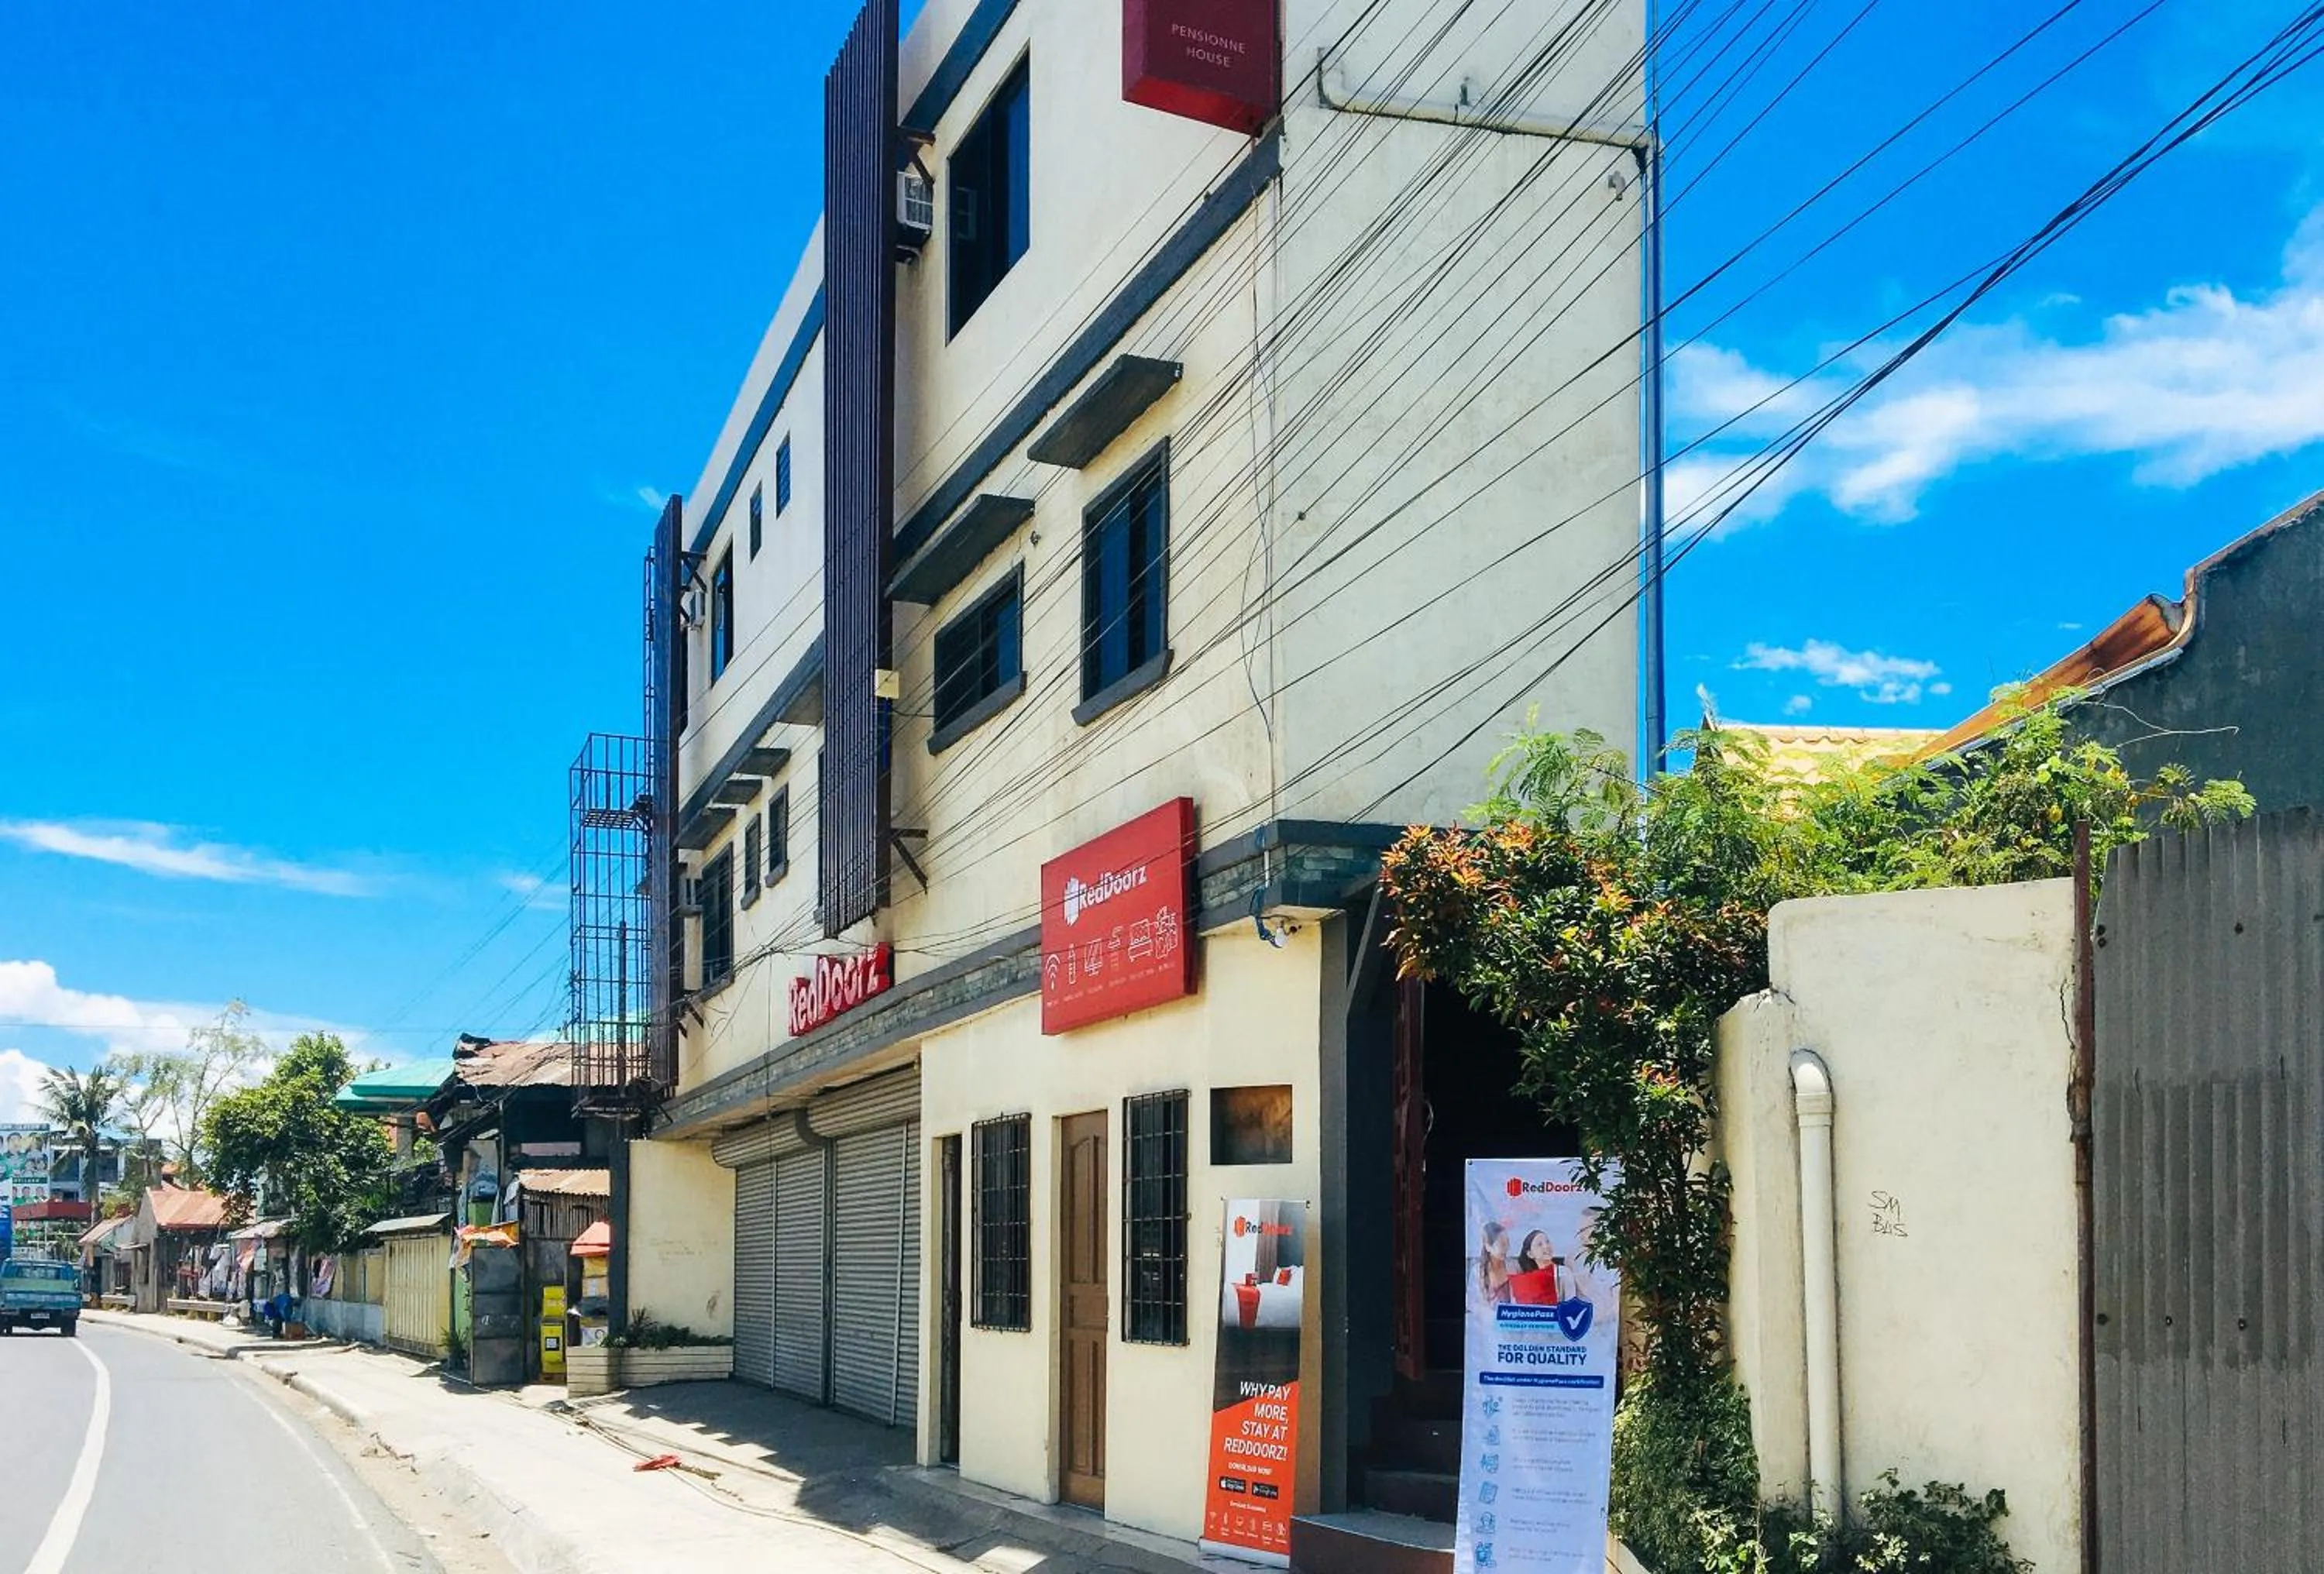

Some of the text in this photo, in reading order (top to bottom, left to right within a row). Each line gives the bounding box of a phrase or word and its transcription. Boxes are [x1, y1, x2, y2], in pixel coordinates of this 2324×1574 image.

[1171, 23, 1246, 55] PENSIONNE
[1186, 46, 1231, 68] HOUSE
[1078, 865, 1148, 910] RedDoorz
[788, 943, 882, 1034] RedDoorz
[1521, 1181, 1583, 1194] RedDoorz
[1497, 1352, 1587, 1366] FOR QUALITY
[1239, 1381, 1291, 1401] WHY PAY
[1254, 1402, 1288, 1425] MORE,
[1241, 1420, 1288, 1442] STAY AT
[1223, 1437, 1288, 1462] REDDOORZ!
